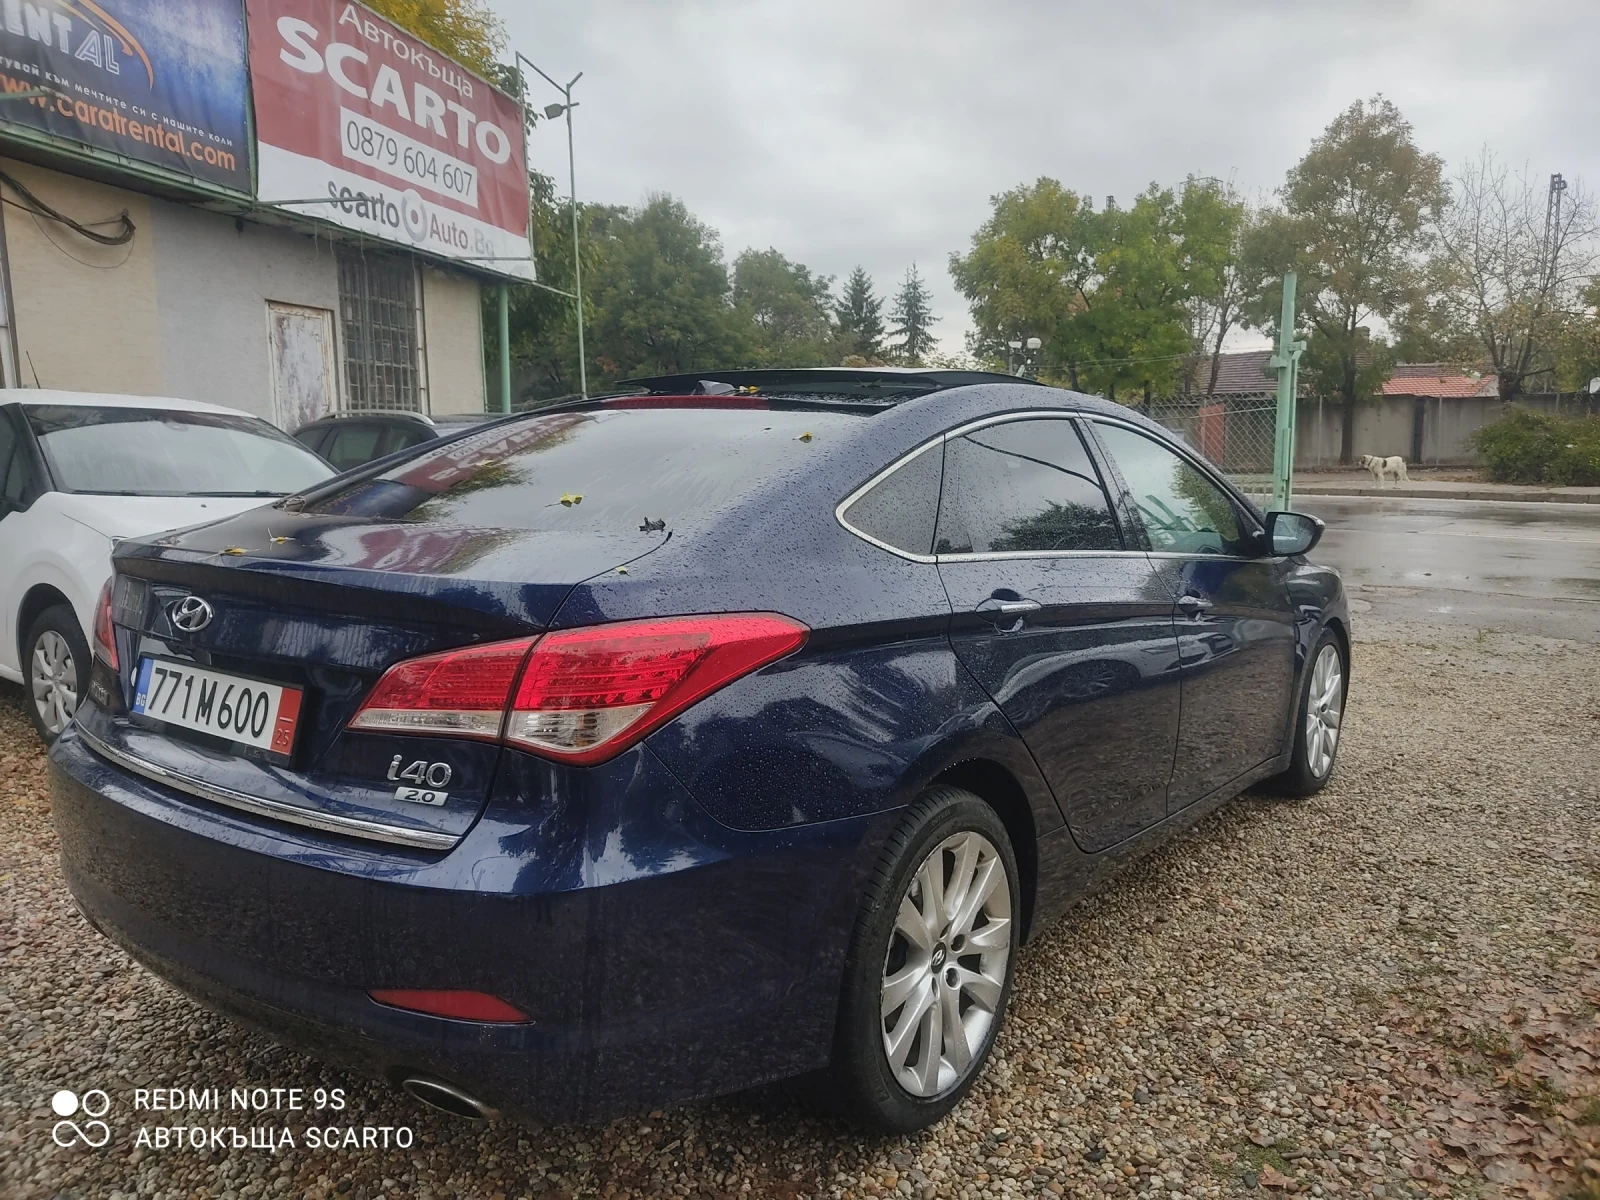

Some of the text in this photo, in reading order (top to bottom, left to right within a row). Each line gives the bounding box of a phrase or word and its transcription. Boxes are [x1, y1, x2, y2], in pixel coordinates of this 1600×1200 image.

[0, 0, 119, 75] ENTAL
[338, 4, 473, 99] Автокъща
[0, 73, 236, 172] ww.caratrental.com
[45, 71, 70, 87] към
[74, 83, 127, 109] мечтите
[132, 105, 146, 117] си
[151, 112, 158, 120] с
[163, 116, 205, 137] нашите
[208, 132, 233, 147] коли
[277, 16, 511, 164] SCARTO
[347, 120, 473, 196] 0879 604 607
[135, 692, 146, 707] BG
[148, 667, 269, 739] 771M600
[276, 728, 291, 746] 25
[386, 754, 452, 788] i40
[404, 790, 436, 803] 2.0
